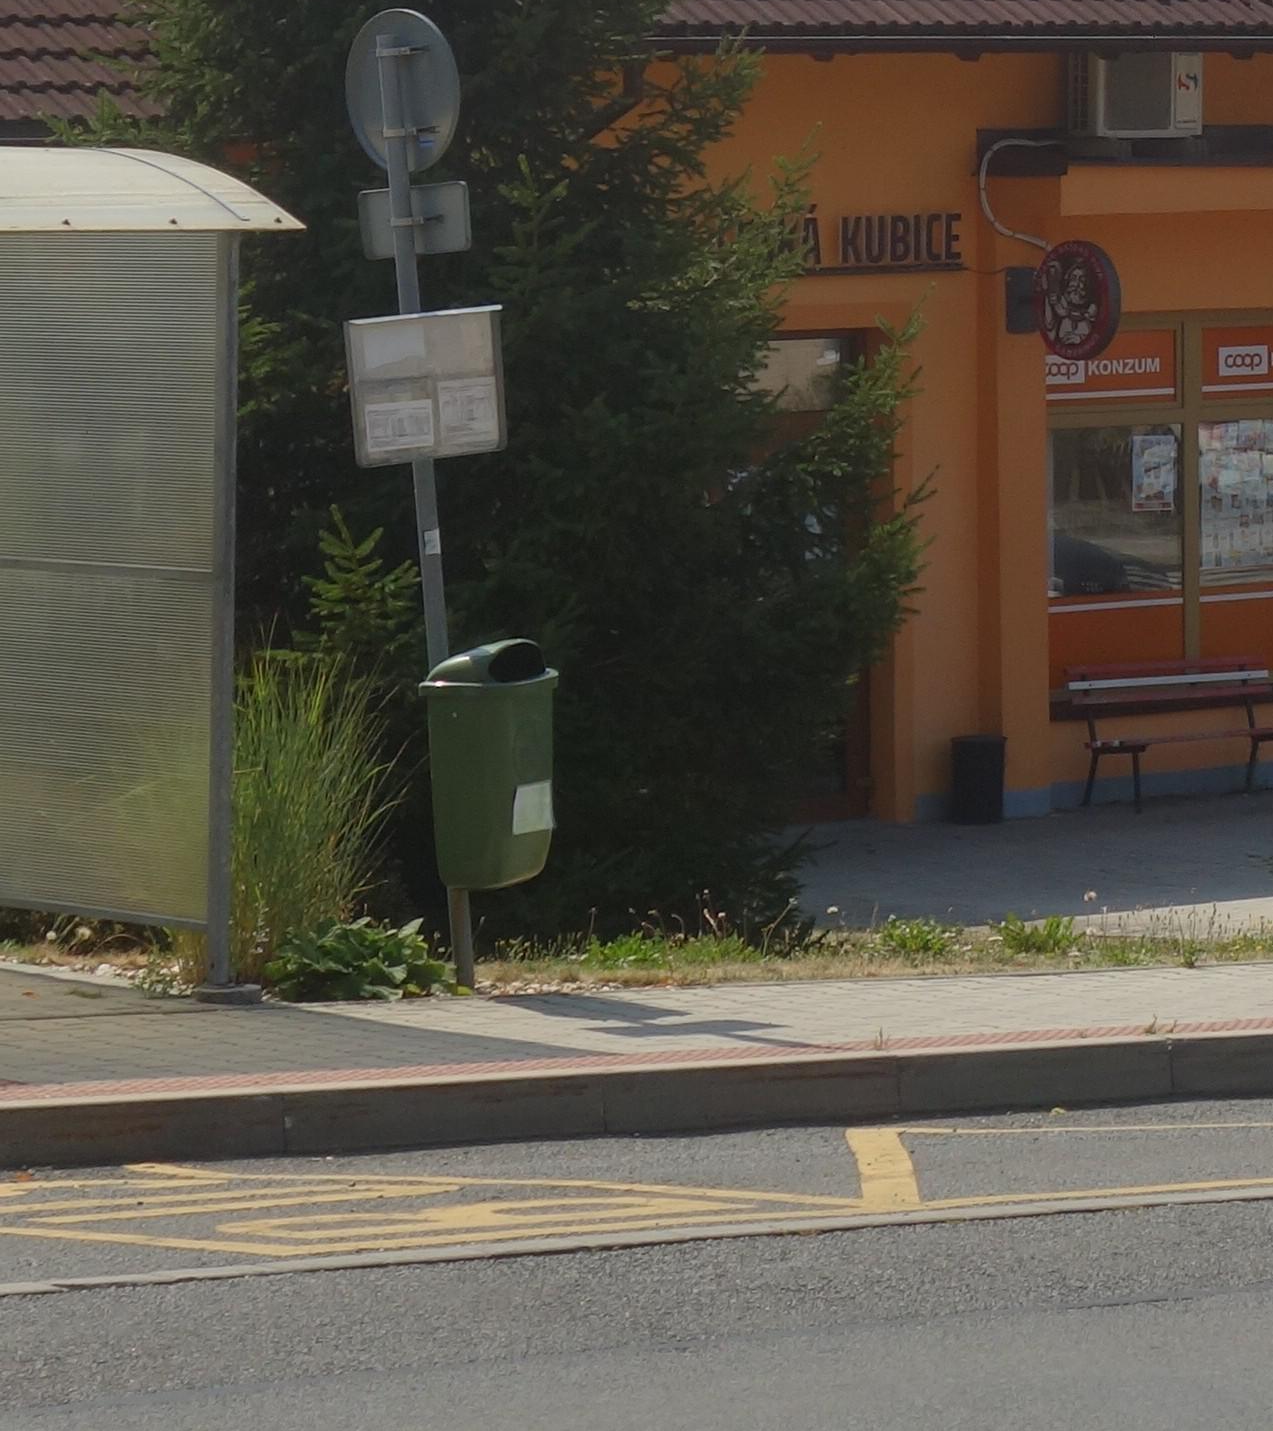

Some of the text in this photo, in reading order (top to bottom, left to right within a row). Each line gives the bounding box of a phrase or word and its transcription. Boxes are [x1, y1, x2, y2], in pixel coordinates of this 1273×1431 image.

[840, 212, 962, 265] KUBICE
[1088, 357, 1160, 376] KONZUM
[1225, 351, 1263, 372] coop
